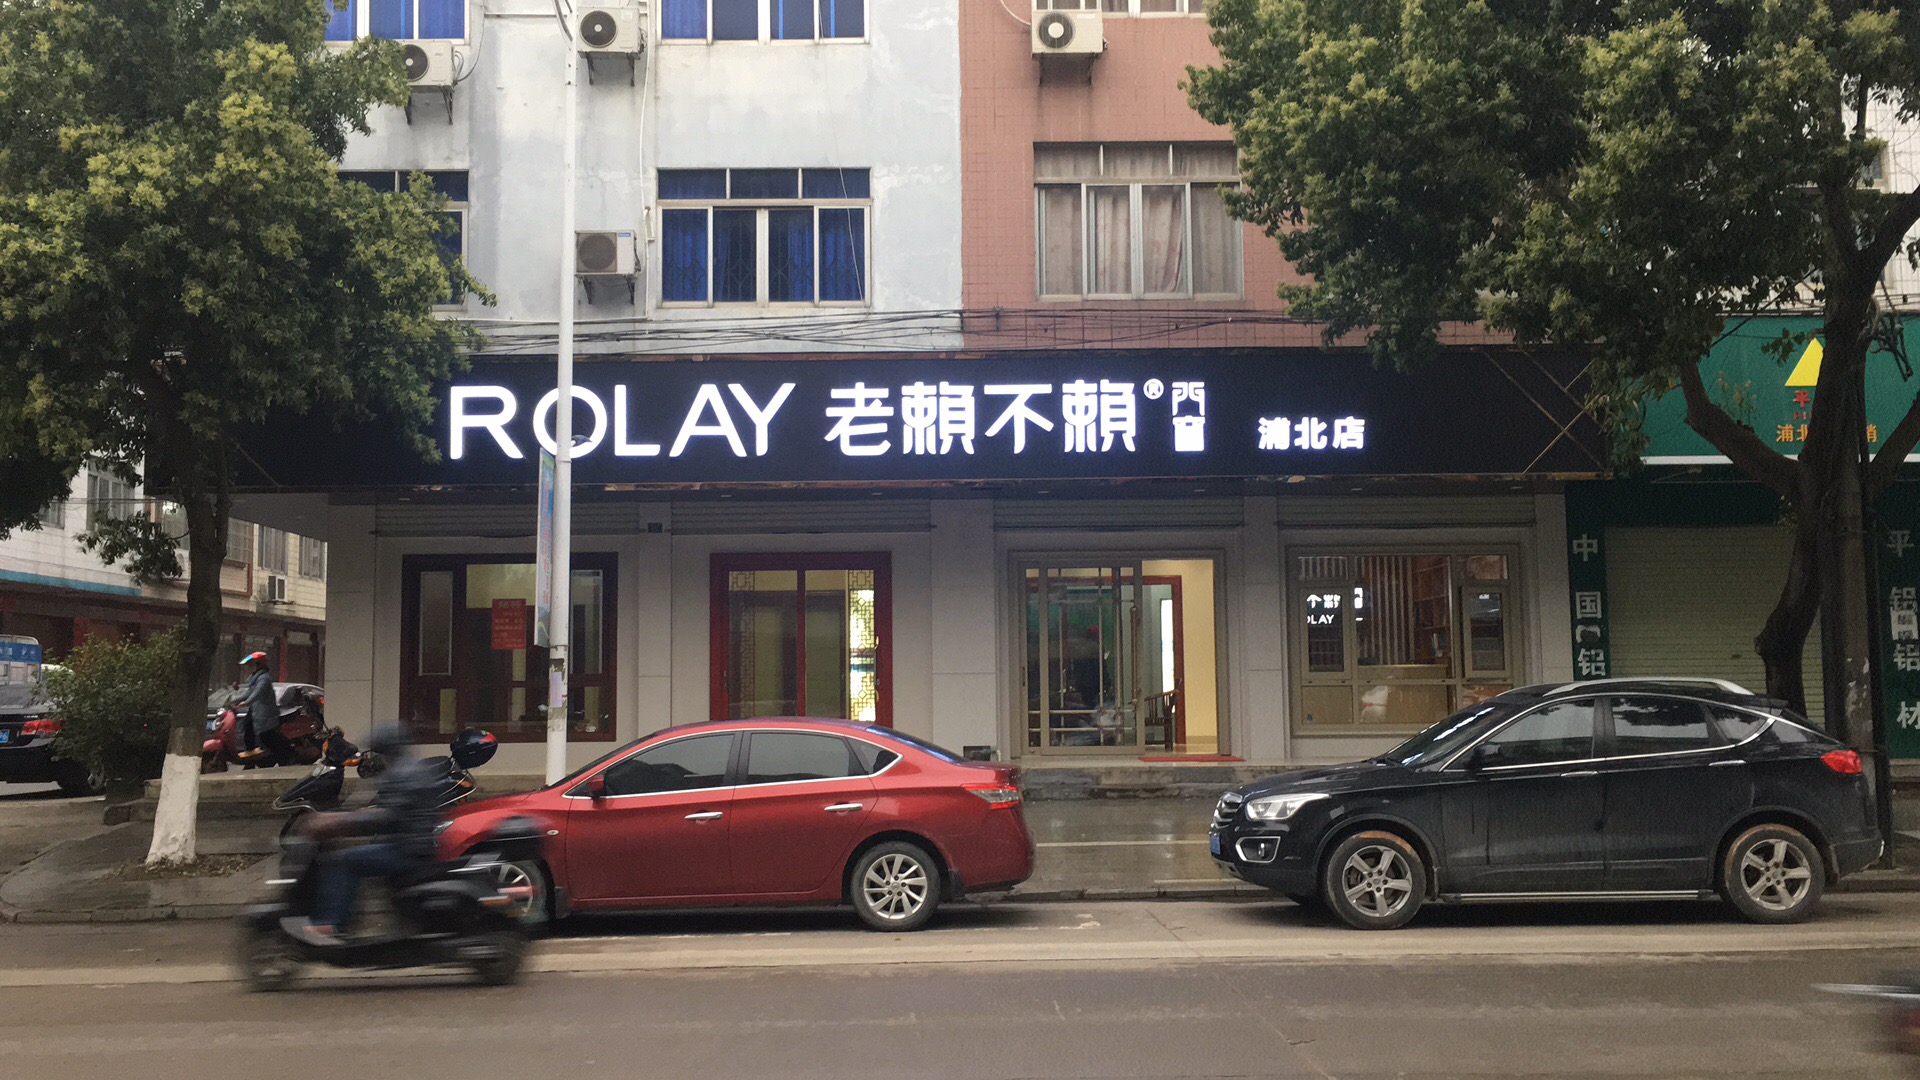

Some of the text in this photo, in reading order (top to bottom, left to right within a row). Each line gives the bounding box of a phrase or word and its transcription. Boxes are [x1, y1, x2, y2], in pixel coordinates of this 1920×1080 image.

[449, 381, 797, 460] ROLAY
[1257, 415, 1366, 450] 浦北店
[1307, 614, 1335, 625] LAY
